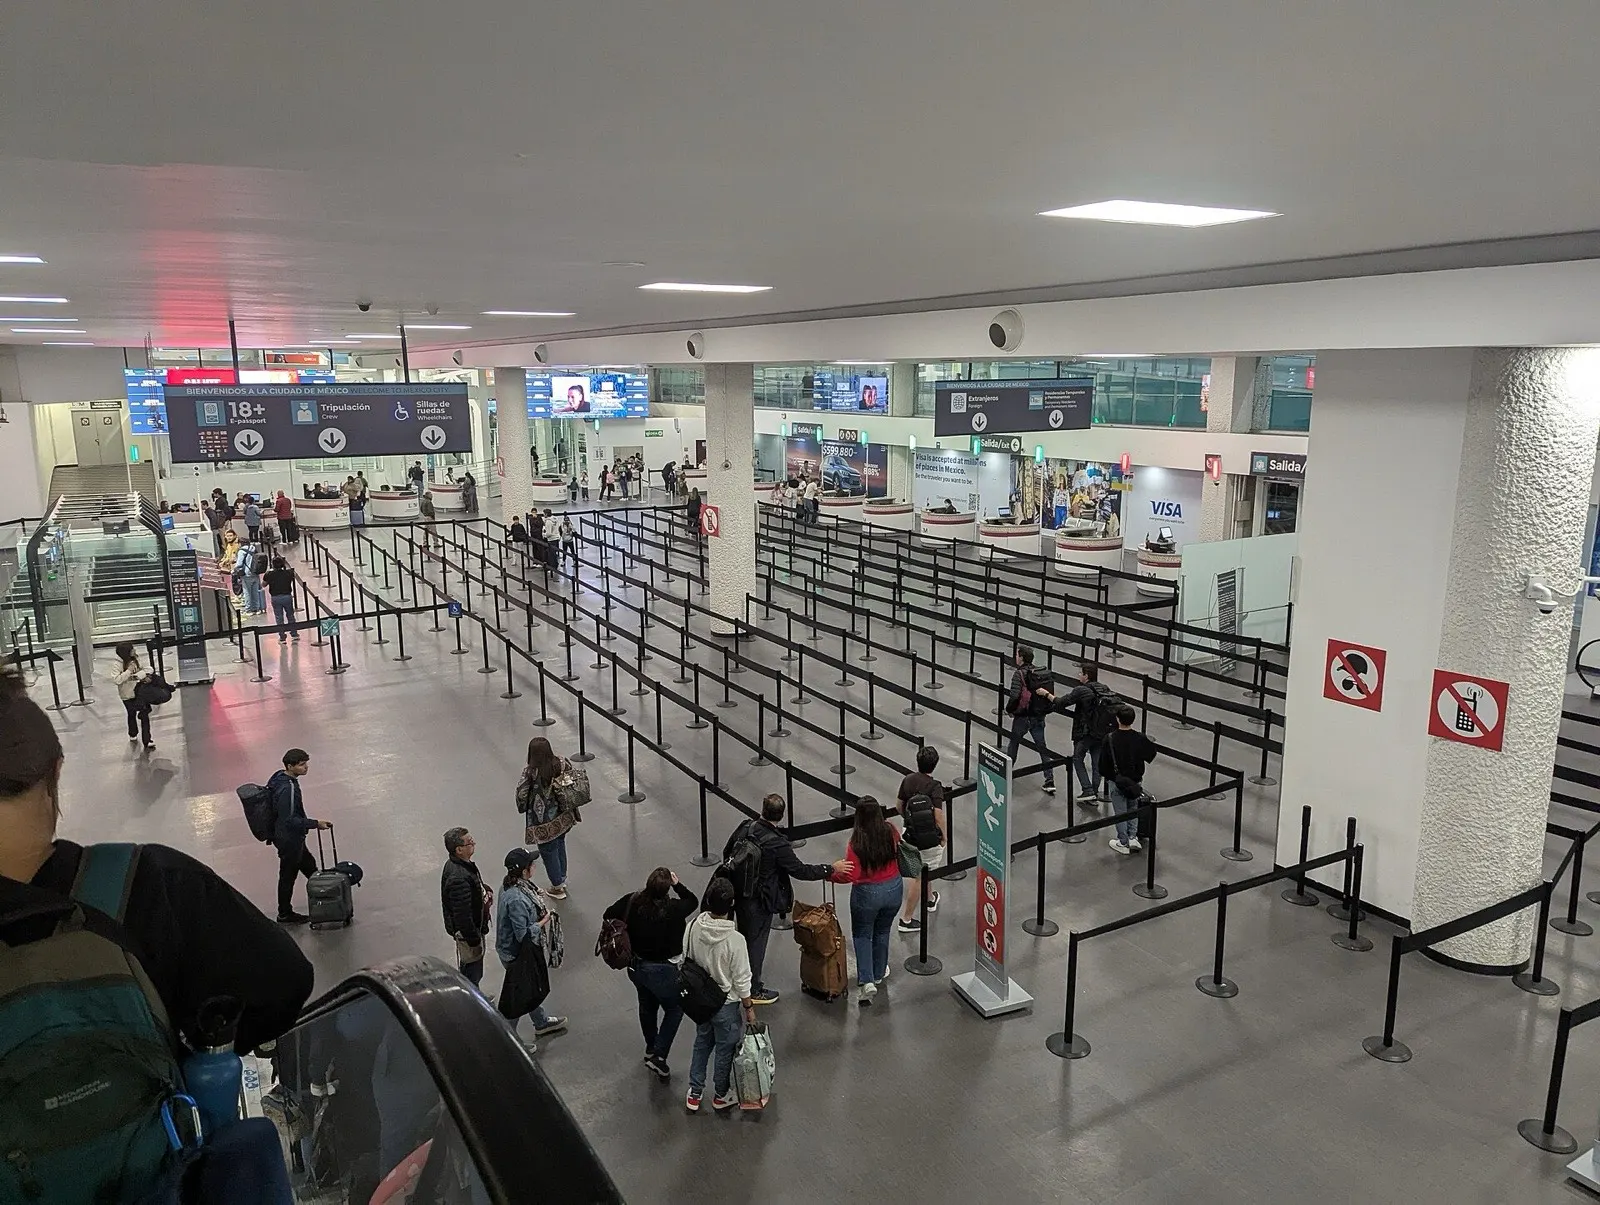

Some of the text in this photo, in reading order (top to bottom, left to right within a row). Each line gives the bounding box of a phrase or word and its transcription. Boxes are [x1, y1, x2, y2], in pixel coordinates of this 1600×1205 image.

[317, 386, 348, 394] MÉXICO
[968, 395, 999, 403] Extranjeros
[320, 403, 370, 412] Tripulación
[416, 400, 438, 408] Sillas
[228, 401, 266, 418] 18+
[822, 444, 854, 457] $599,880
[932, 456, 956, 464] accepted
[944, 466, 966, 474] Mexico.
[1150, 500, 1182, 518] VISA
[180, 624, 199, 633] 18+
